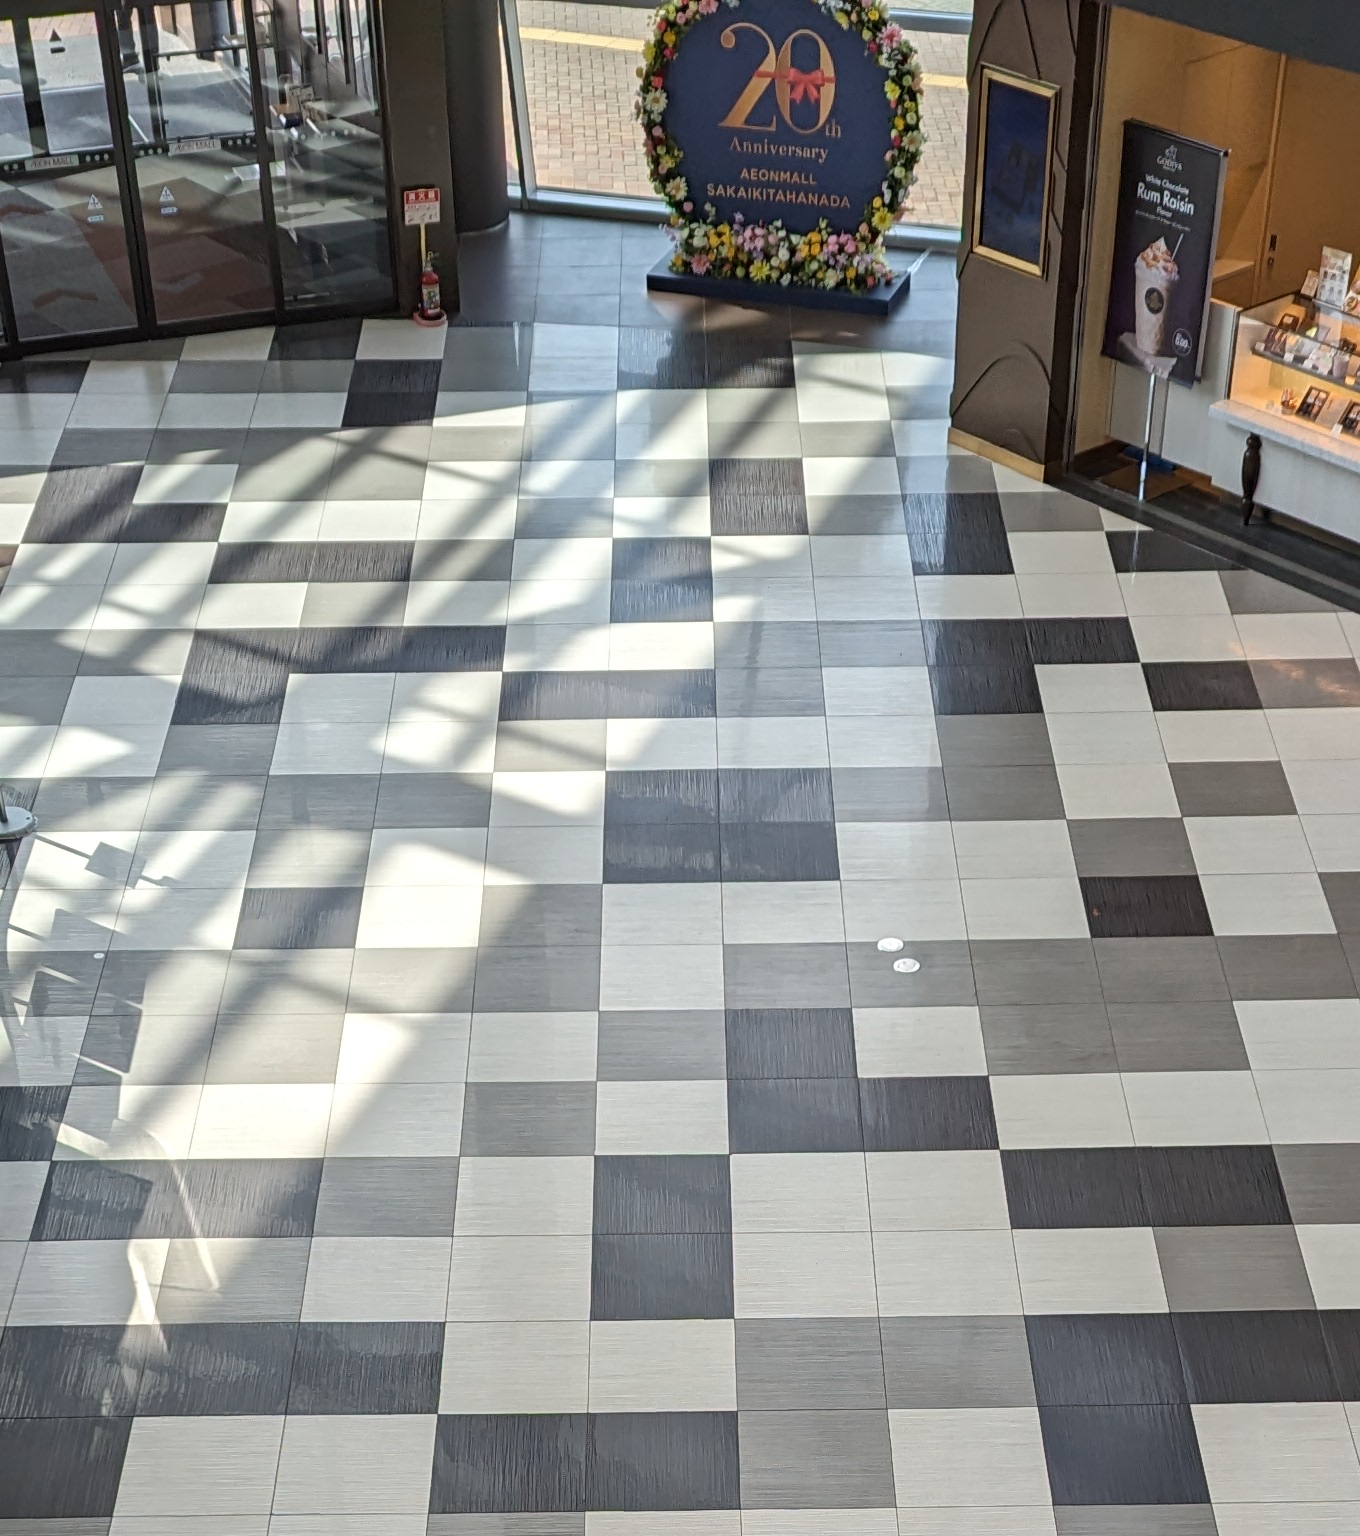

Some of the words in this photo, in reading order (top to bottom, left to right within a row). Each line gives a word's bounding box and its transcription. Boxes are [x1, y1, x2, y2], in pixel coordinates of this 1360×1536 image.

[729, 137, 830, 164] Anniversary
[740, 167, 818, 185] AEONMALL
[707, 183, 851, 208] SAKAIKITAHANADA
[1137, 182, 1161, 204] Rum
[1163, 189, 1194, 217] Raisin
